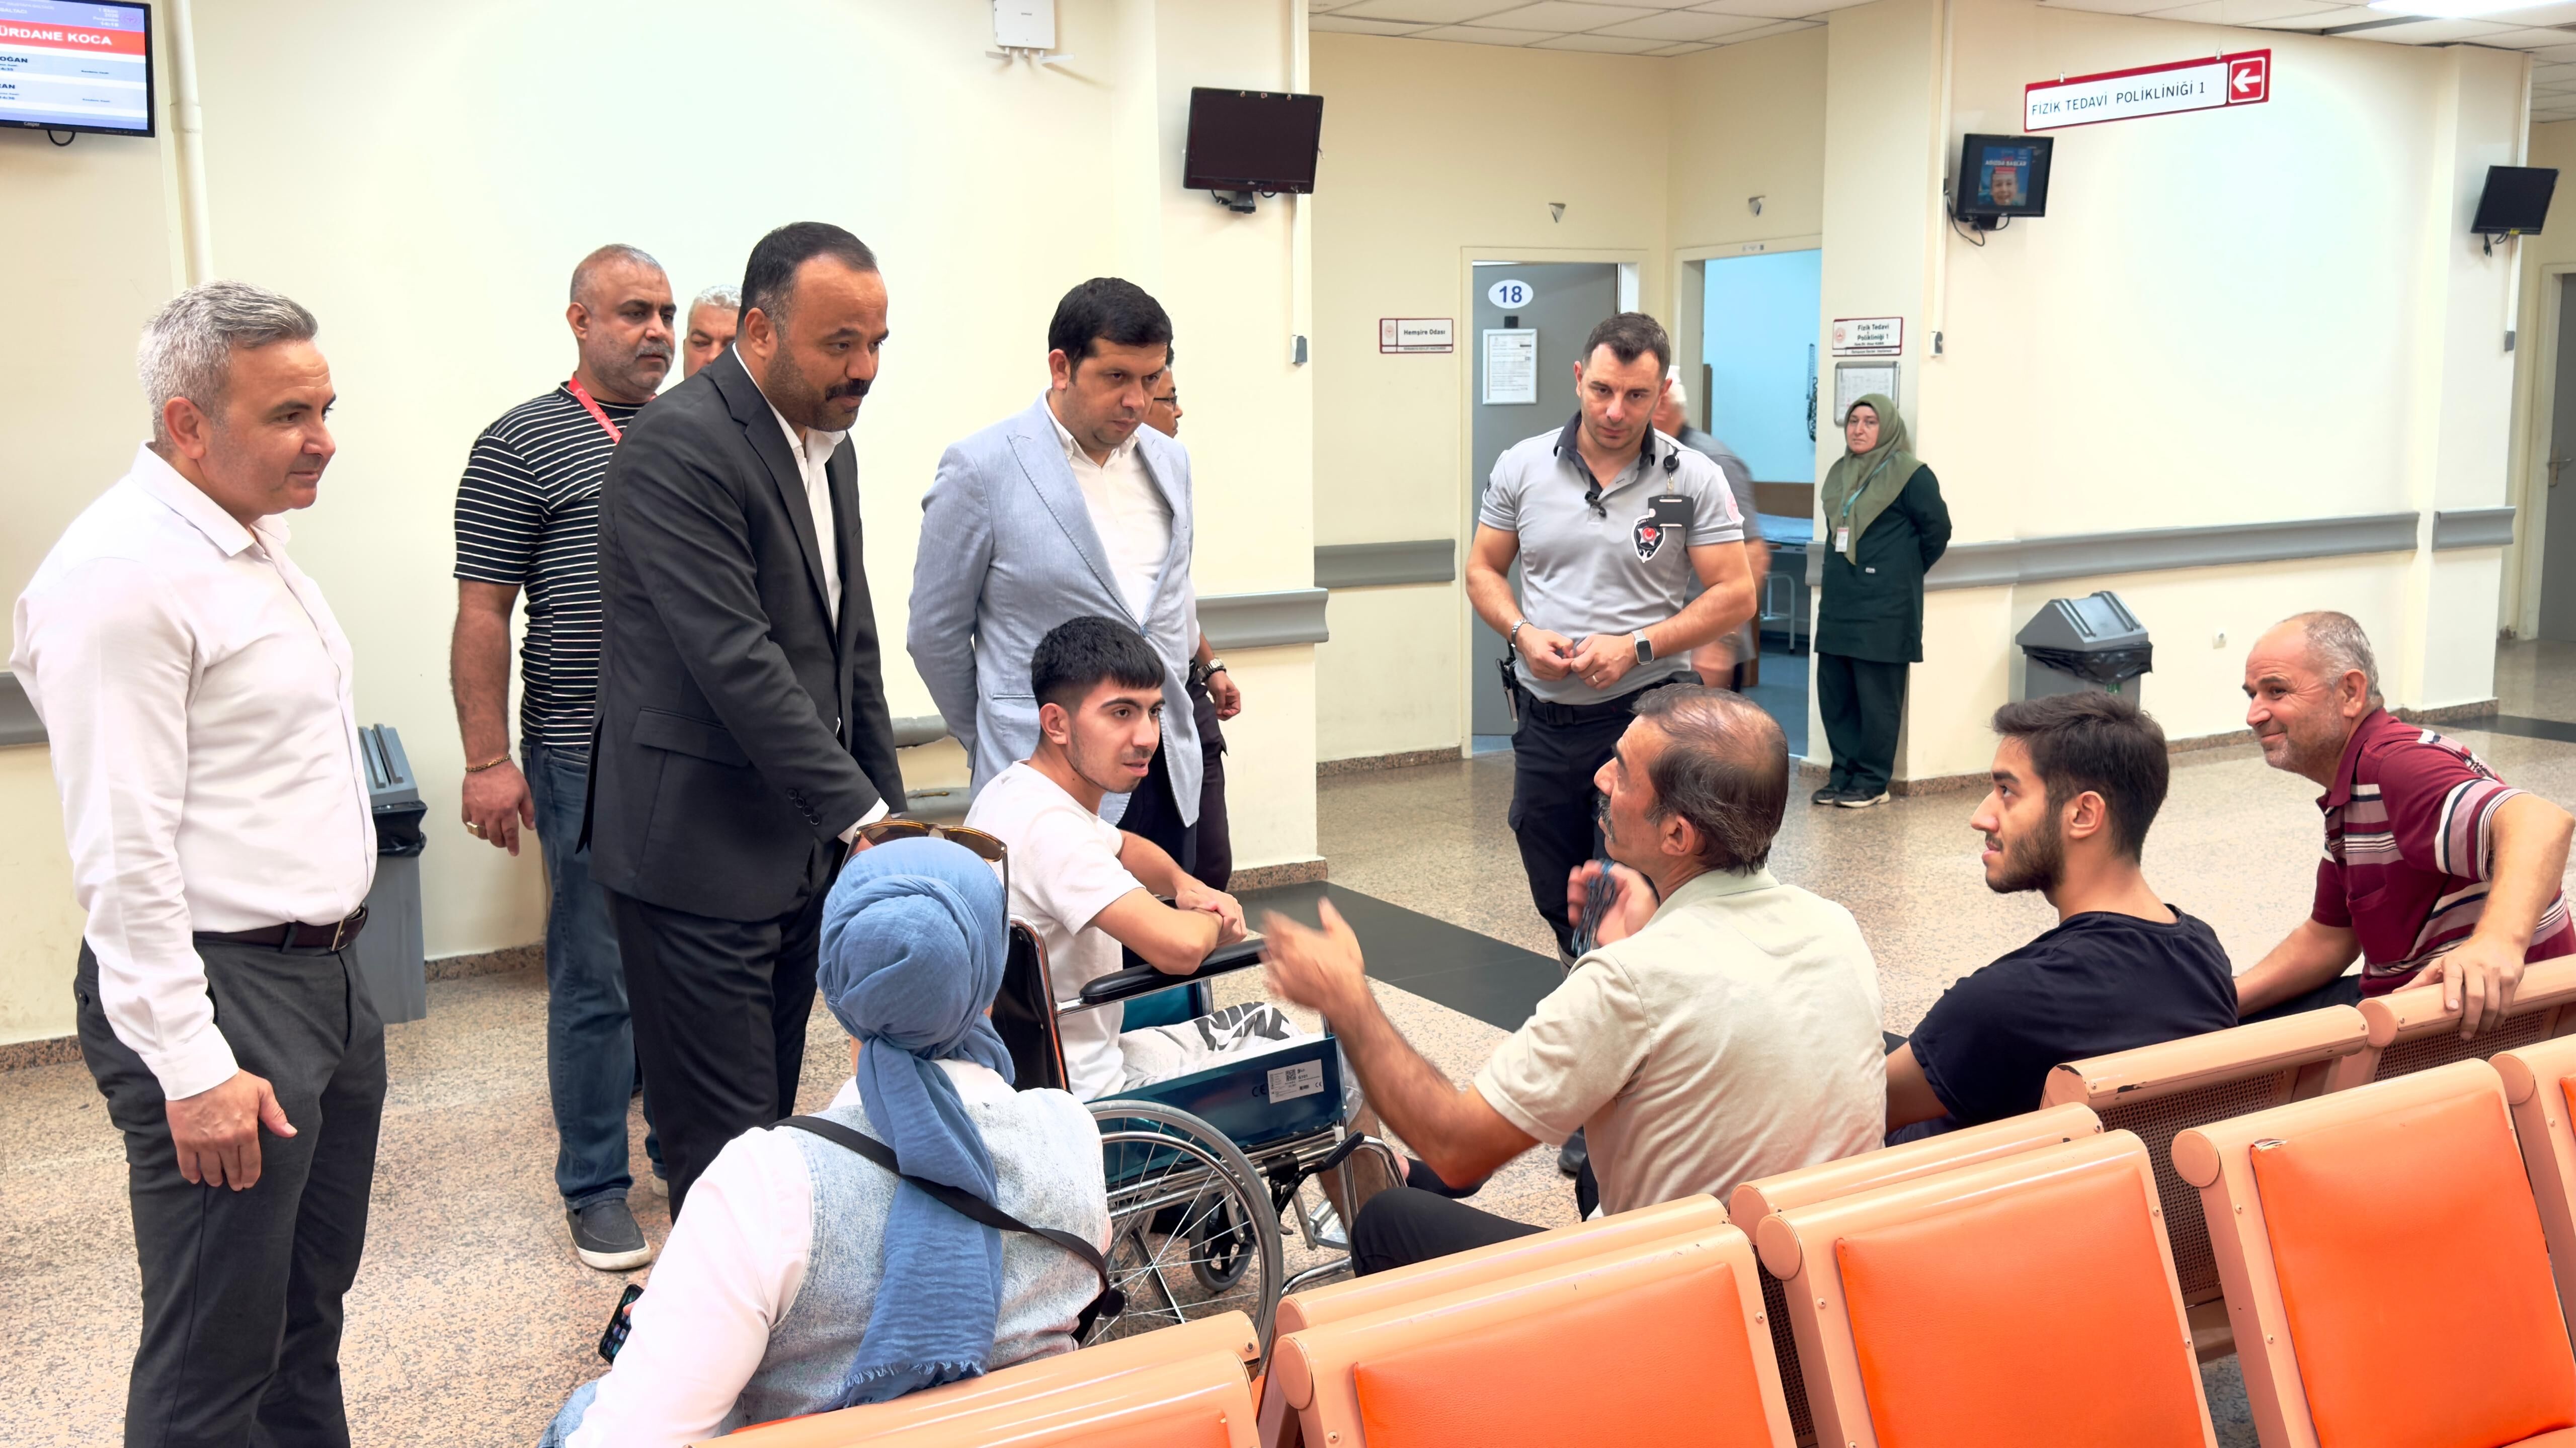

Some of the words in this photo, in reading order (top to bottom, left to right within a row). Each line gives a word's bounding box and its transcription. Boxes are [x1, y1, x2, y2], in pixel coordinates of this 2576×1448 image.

[0, 25, 63, 41] ÜRDANE
[67, 32, 112, 45] KOCA
[2032, 99, 2060, 115] FİZİK
[2065, 92, 2108, 112] TEDAVİ
[2116, 80, 2194, 104] POLİKLİNİĞİ
[2199, 82, 2205, 94] 1
[1499, 286, 1522, 303] 18
